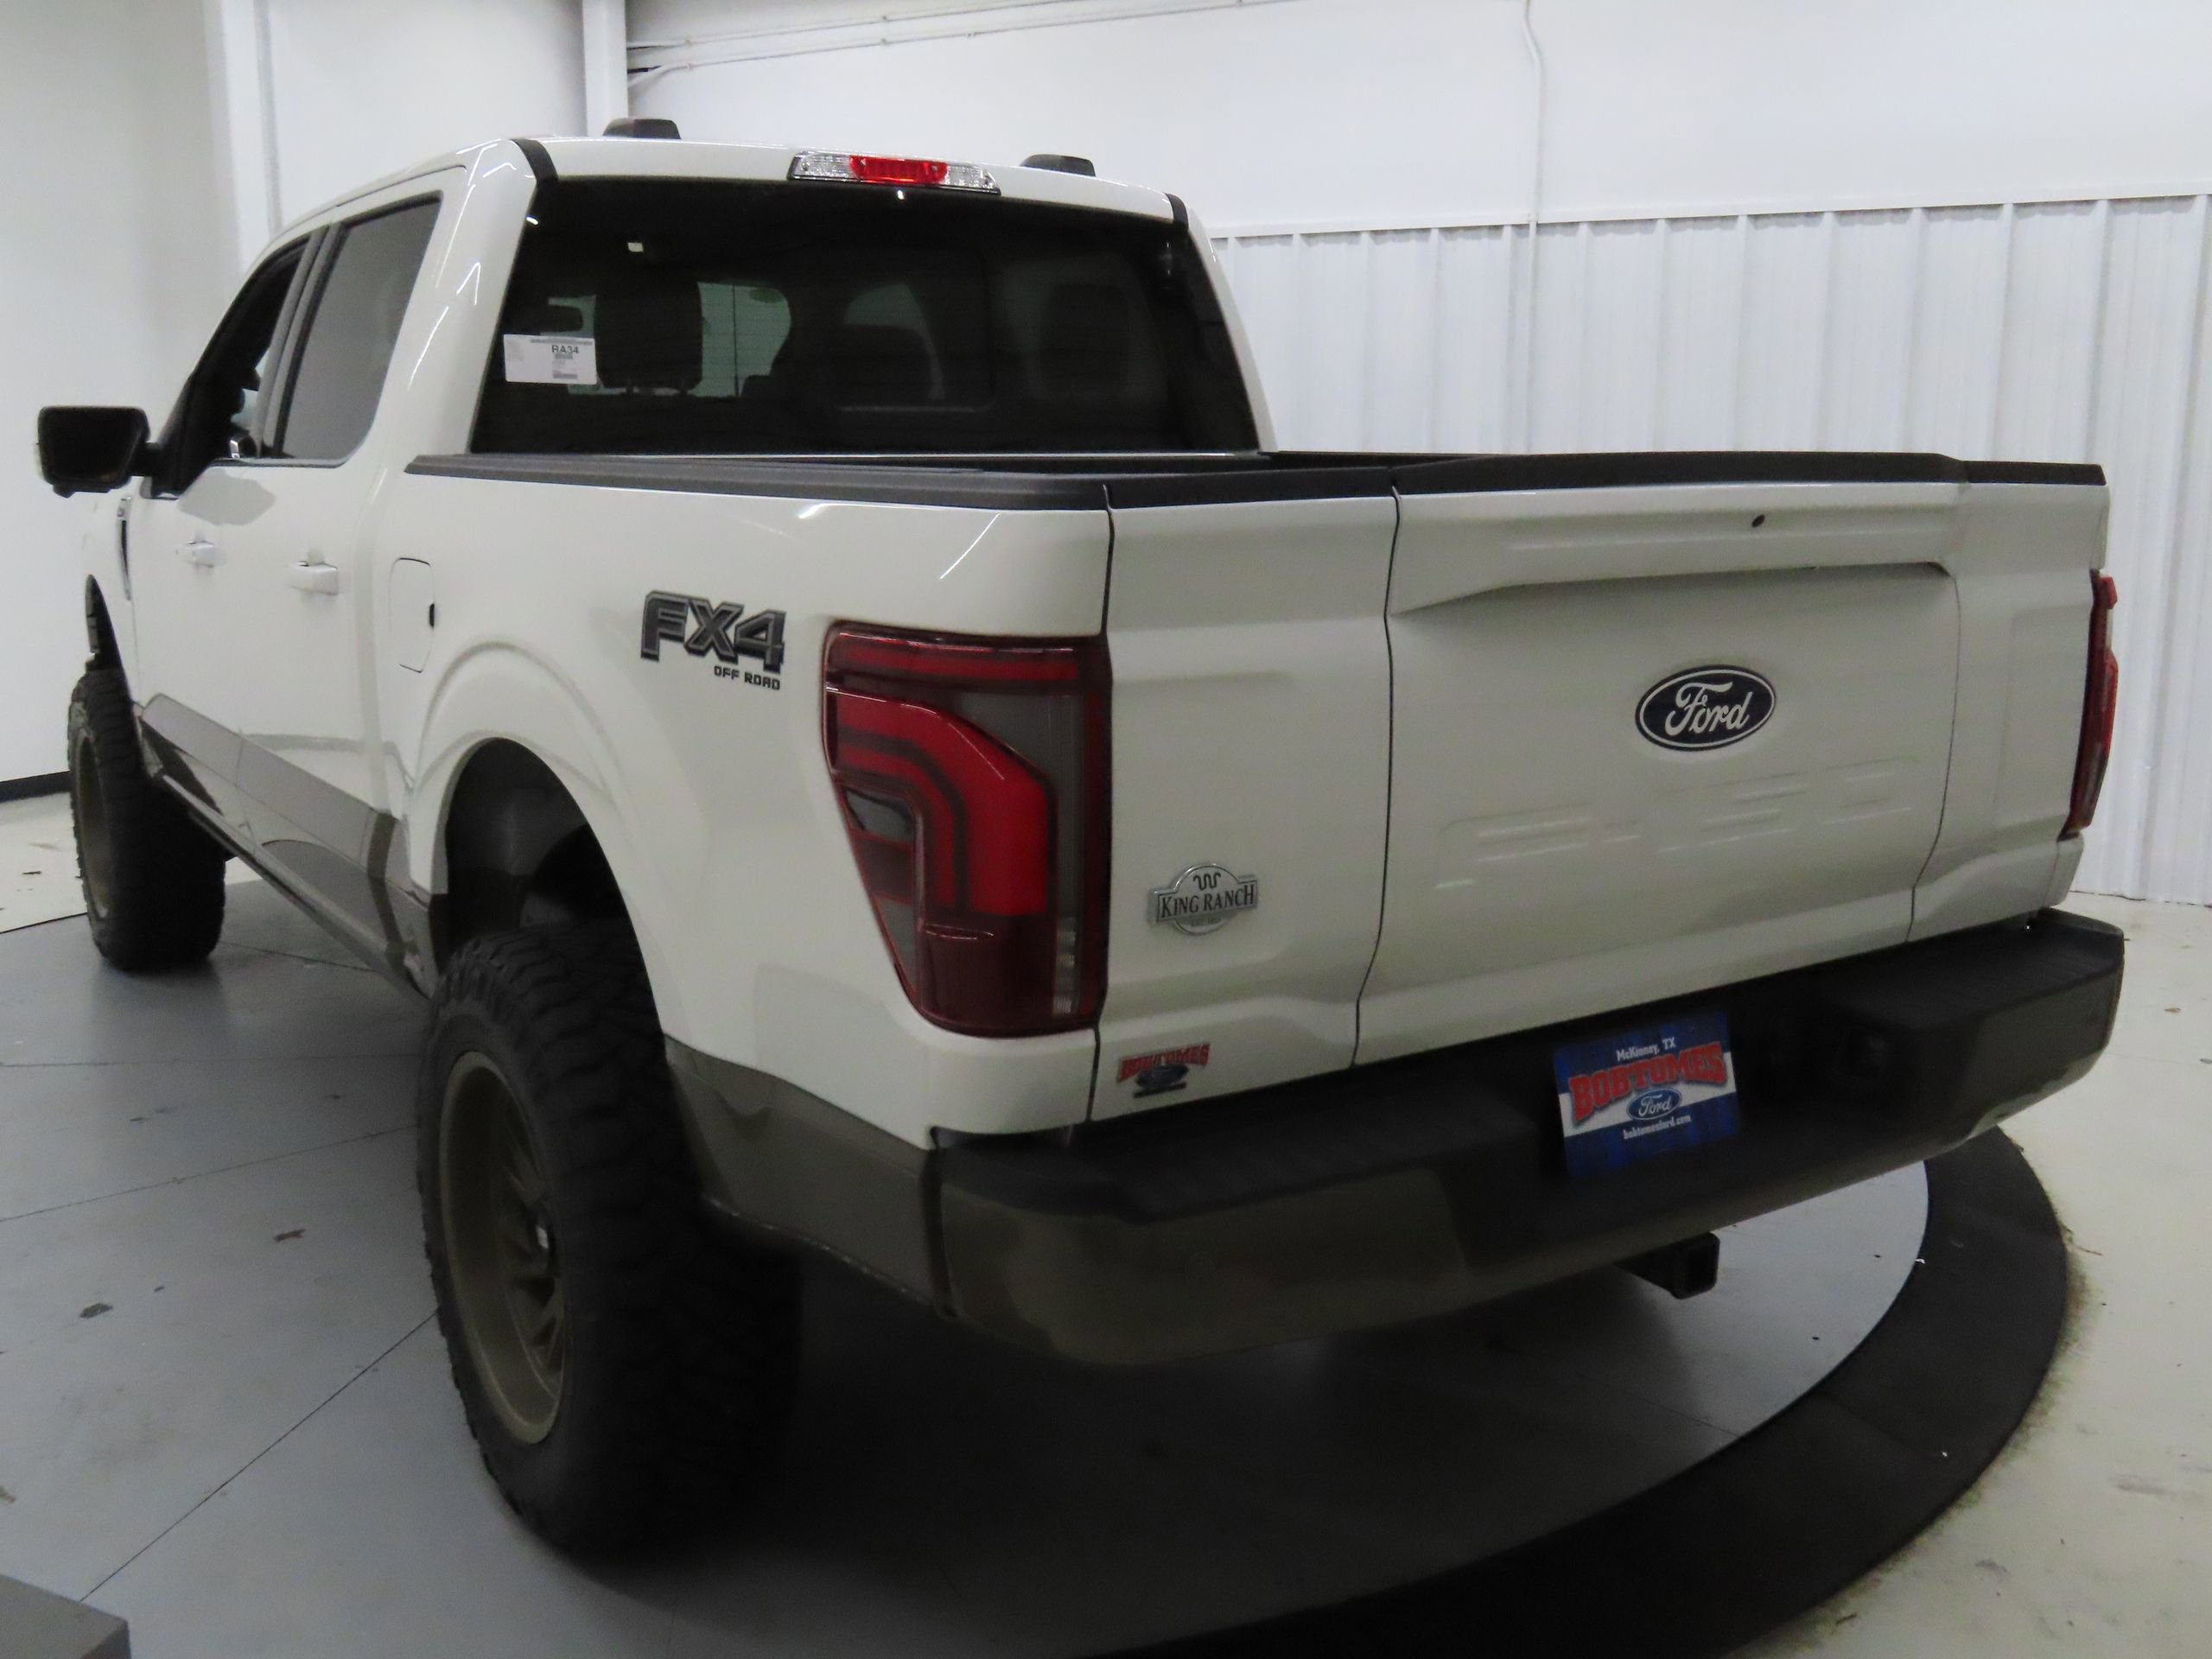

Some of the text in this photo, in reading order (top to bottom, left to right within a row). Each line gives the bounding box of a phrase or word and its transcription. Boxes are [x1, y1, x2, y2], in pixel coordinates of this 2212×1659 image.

[640, 590, 786, 674] FX4
[714, 665, 781, 691] OFF ROAD
[1665, 681, 1753, 736] Ford
[1161, 884, 1254, 918] KING RANCH
[1662, 1037, 1676, 1050] TX
[1638, 1094, 1672, 1117] Ford
